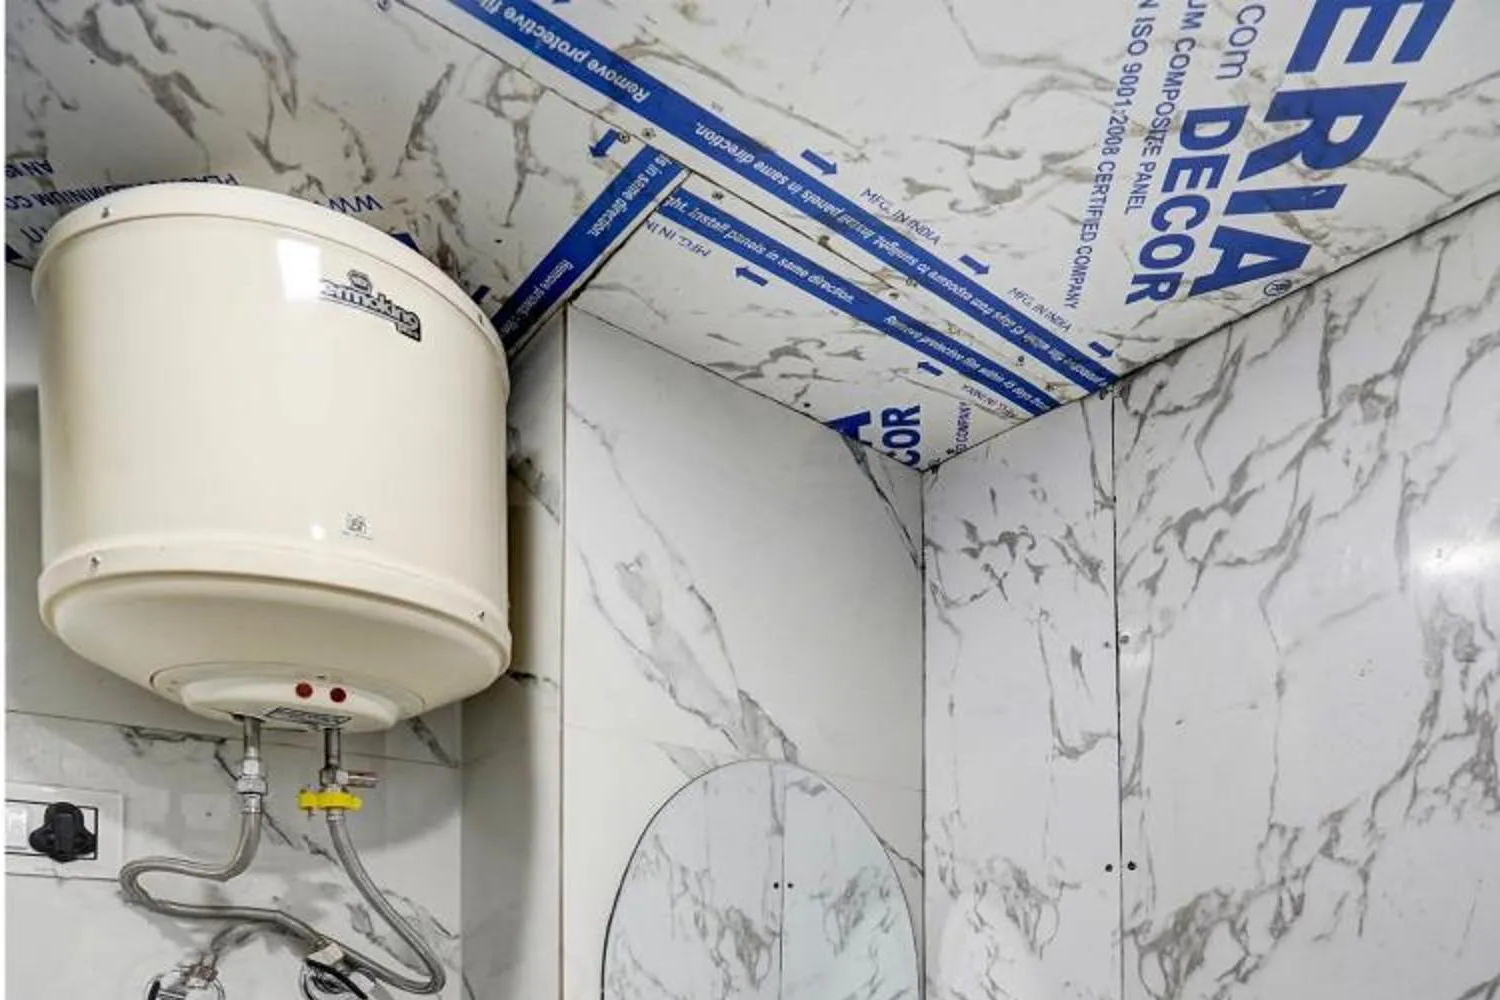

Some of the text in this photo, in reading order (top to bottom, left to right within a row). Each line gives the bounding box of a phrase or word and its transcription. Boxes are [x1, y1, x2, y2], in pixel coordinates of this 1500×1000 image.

[504, 7, 590, 62] protective
[1127, 15, 1154, 56] ISO
[588, 59, 650, 103] Remove
[1101, 62, 1143, 156] 9001:2008
[1140, 36, 1196, 158] COMPOSITE
[754, 161, 788, 184] same
[1079, 161, 1116, 243] CERTIFIED
[1124, 160, 1159, 216] PANEL
[1123, 104, 1251, 306] DECOR
[1065, 244, 1092, 308] COMPANY
